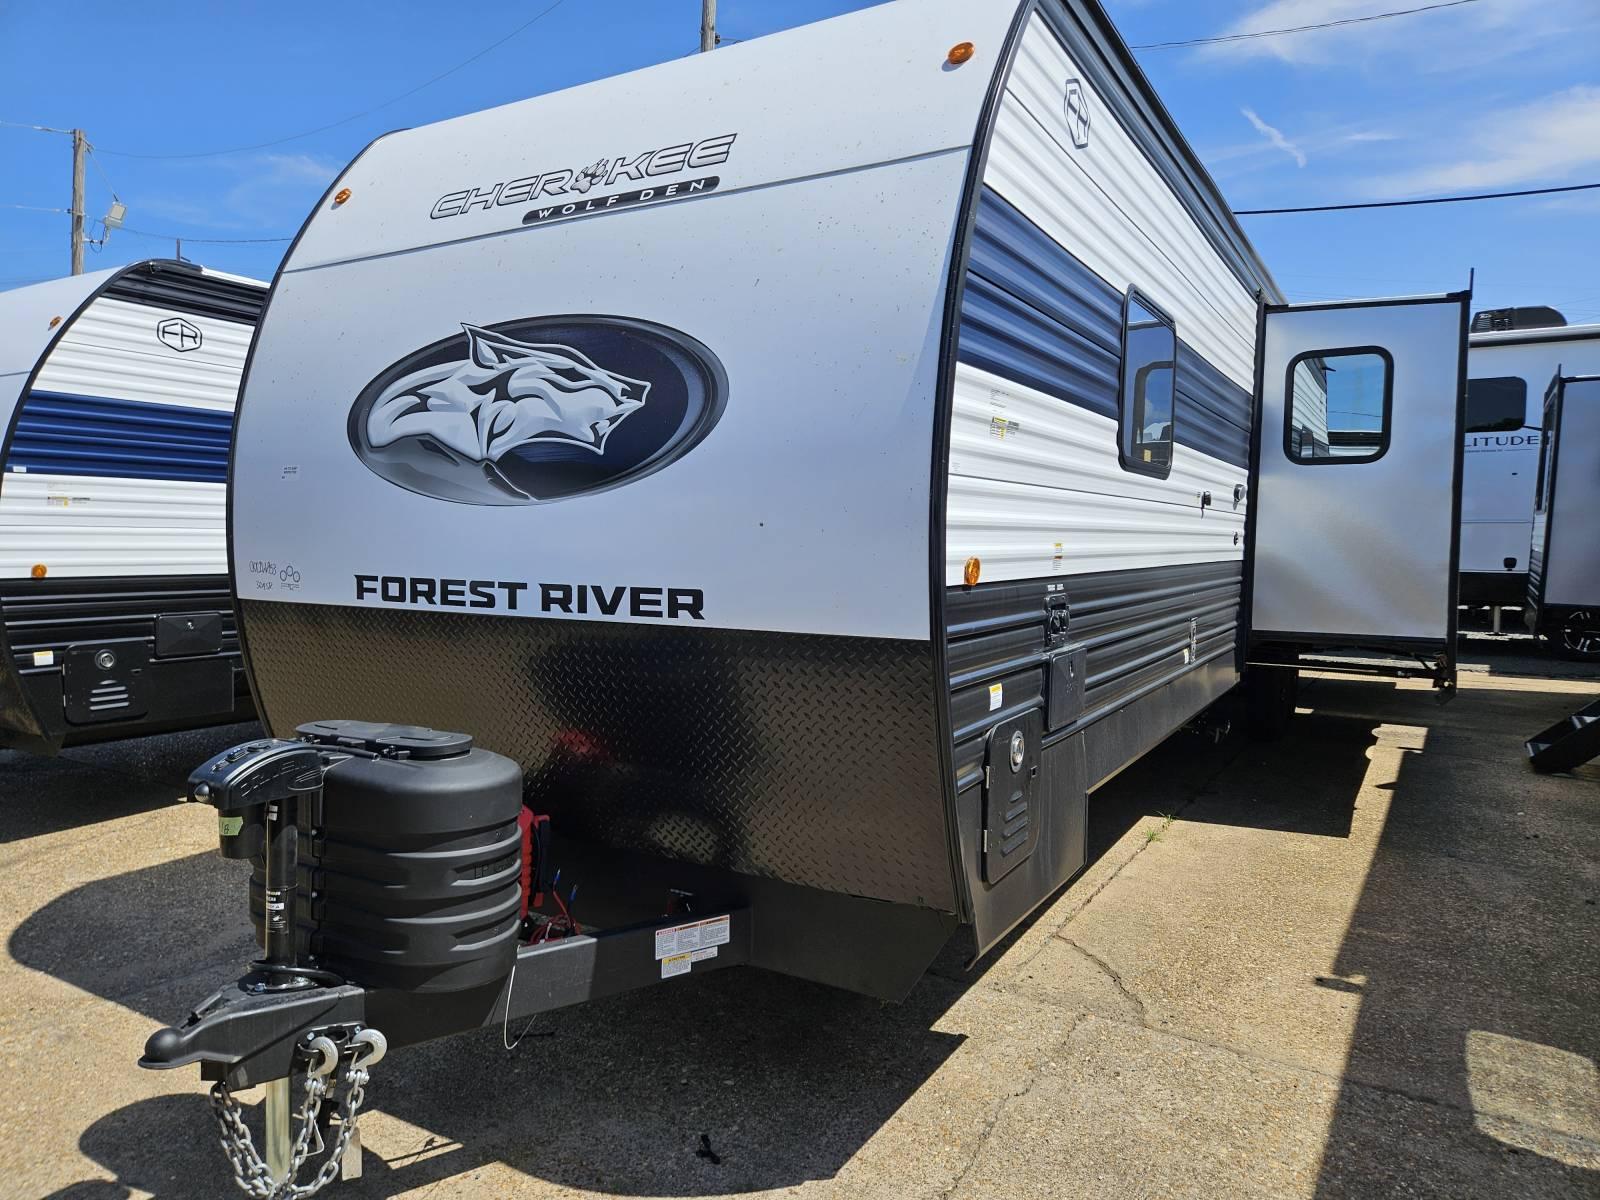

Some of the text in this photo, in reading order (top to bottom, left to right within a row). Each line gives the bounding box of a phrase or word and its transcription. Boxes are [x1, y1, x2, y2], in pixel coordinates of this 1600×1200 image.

[537, 179, 706, 220] WOLF DEN
[354, 574, 705, 620] FOREST RIVER
